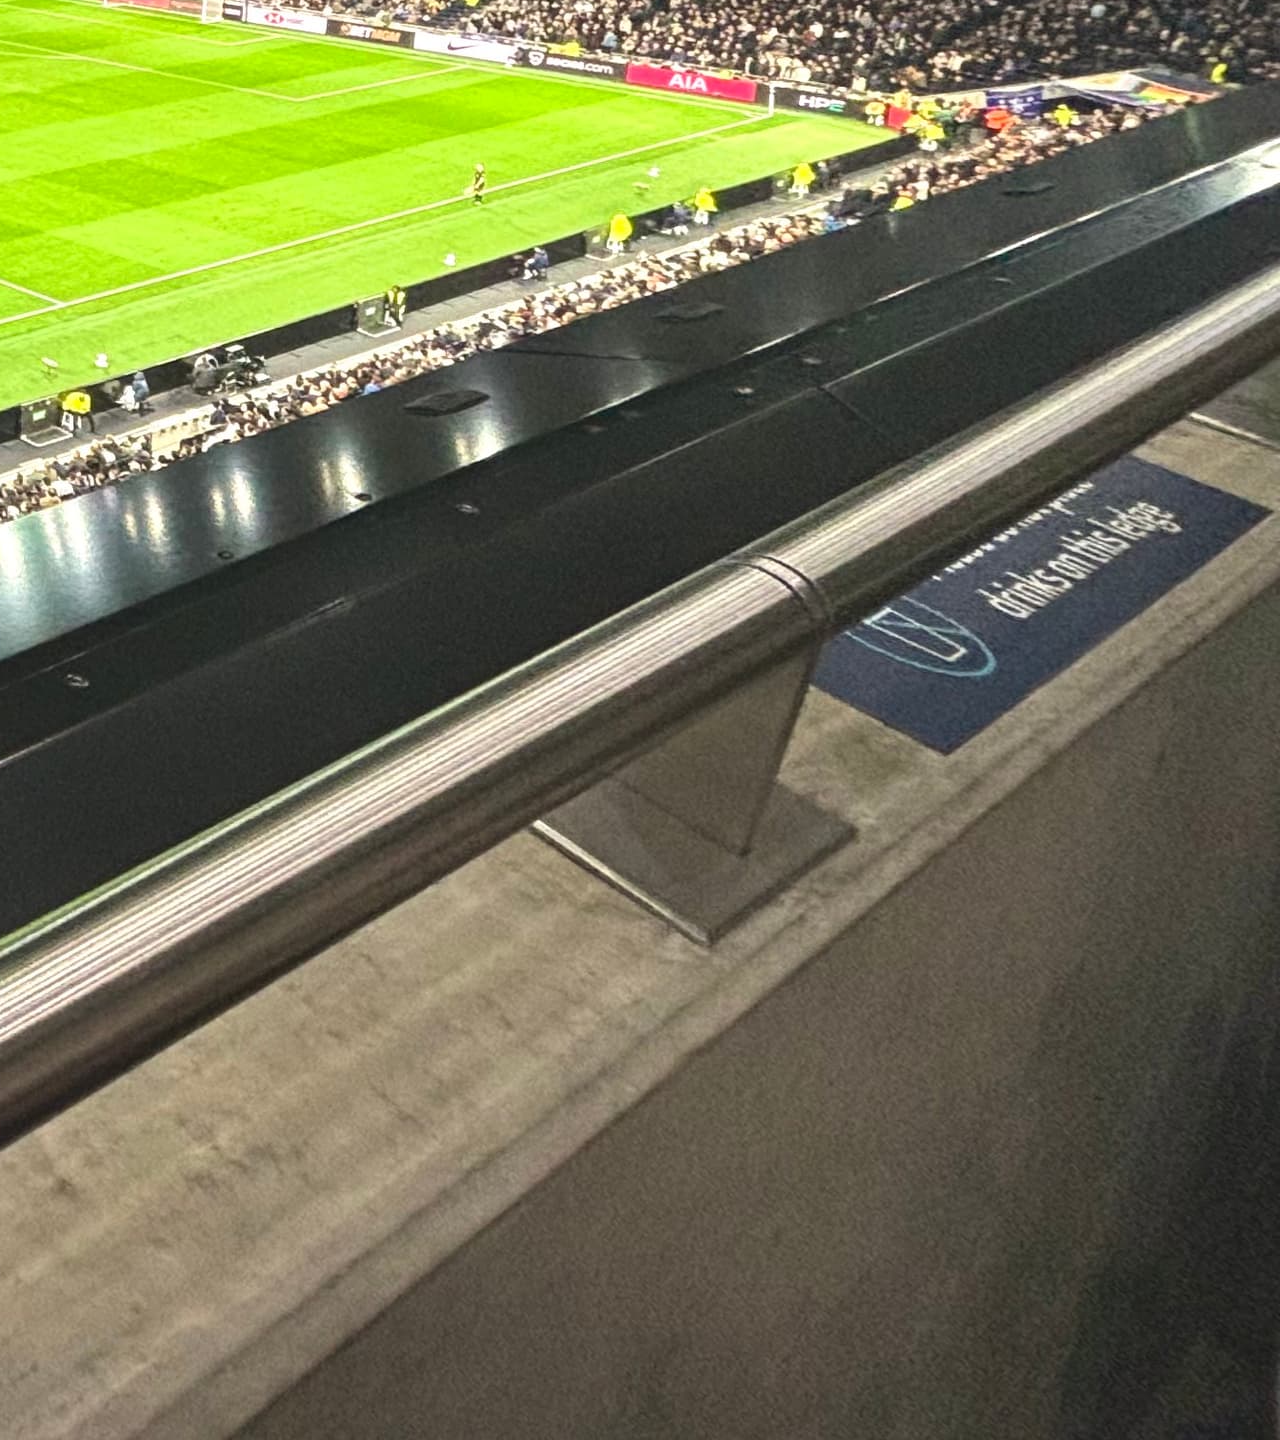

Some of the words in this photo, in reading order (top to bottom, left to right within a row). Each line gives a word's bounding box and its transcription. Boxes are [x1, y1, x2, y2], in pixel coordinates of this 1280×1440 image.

[669, 74, 708, 92] AIA
[799, 95, 846, 113] HPE
[1086, 501, 1183, 541] ledge
[1060, 530, 1132, 564] this
[1048, 553, 1099, 580] on
[976, 569, 1073, 619] drinks
